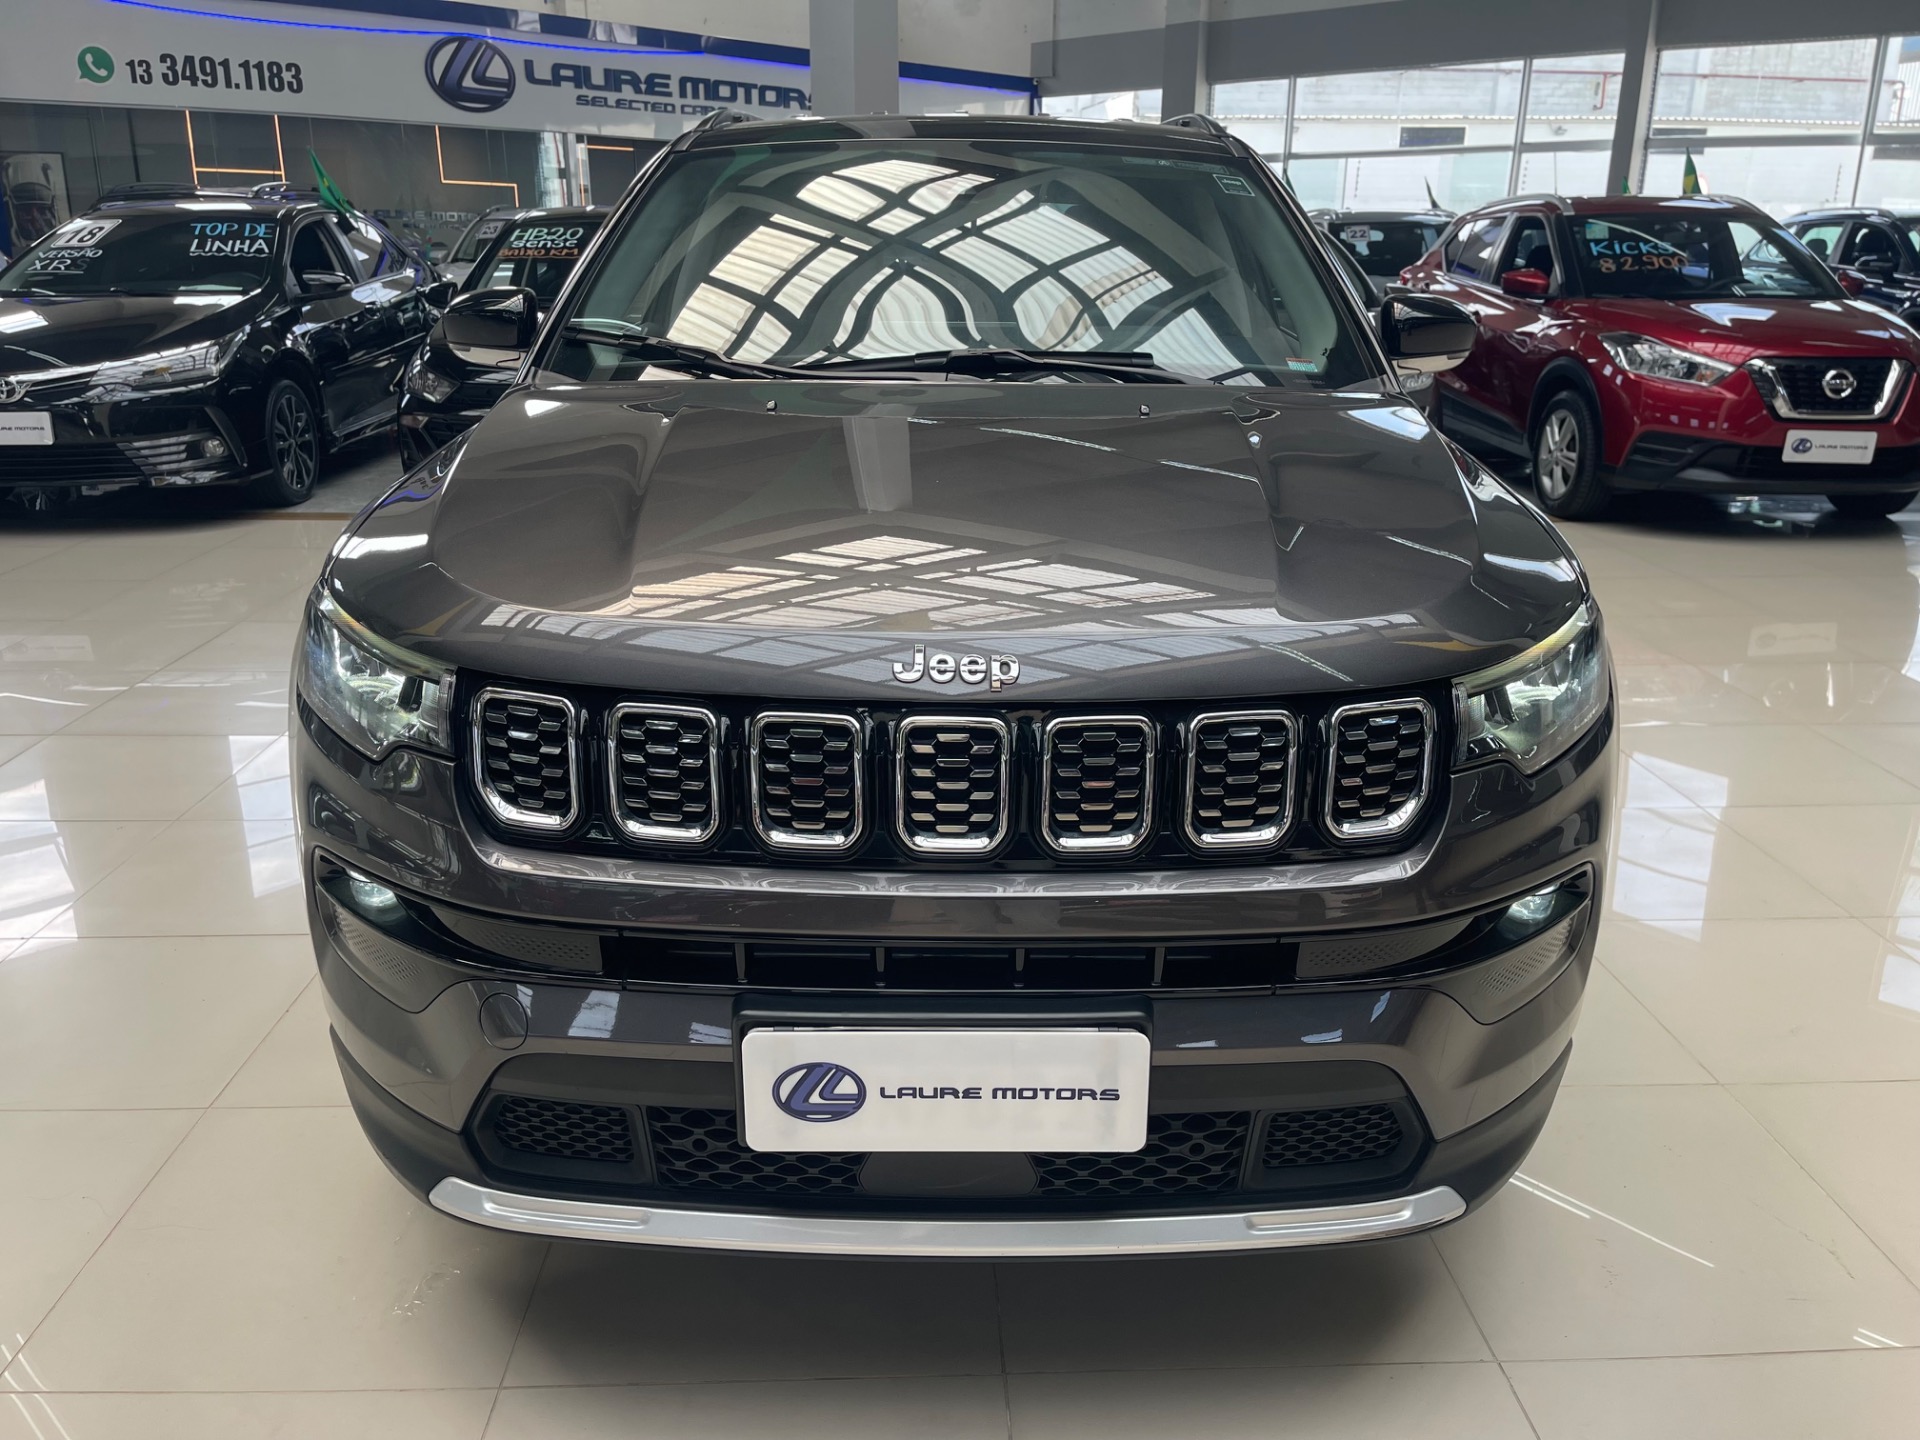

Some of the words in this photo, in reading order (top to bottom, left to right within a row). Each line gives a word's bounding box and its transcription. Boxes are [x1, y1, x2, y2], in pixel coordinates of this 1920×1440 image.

[125, 59, 153, 85] 13
[159, 53, 303, 94] 3491.1183
[523, 59, 673, 98] LAURE
[679, 75, 811, 111] MOTOR
[576, 94, 676, 114] SELECTED
[680, 104, 728, 116] CAR
[64, 226, 105, 244] 18
[190, 222, 239, 236] TOP
[244, 222, 275, 238] DE
[510, 227, 584, 241] HB20
[1350, 230, 1368, 239] 22
[511, 239, 578, 248] sense
[38, 248, 103, 259] VERSÃO
[549, 248, 579, 256] KM
[892, 644, 1020, 692] Jeep
[879, 1086, 983, 1100] LAURE
[991, 1087, 1120, 1101] MOTORS
